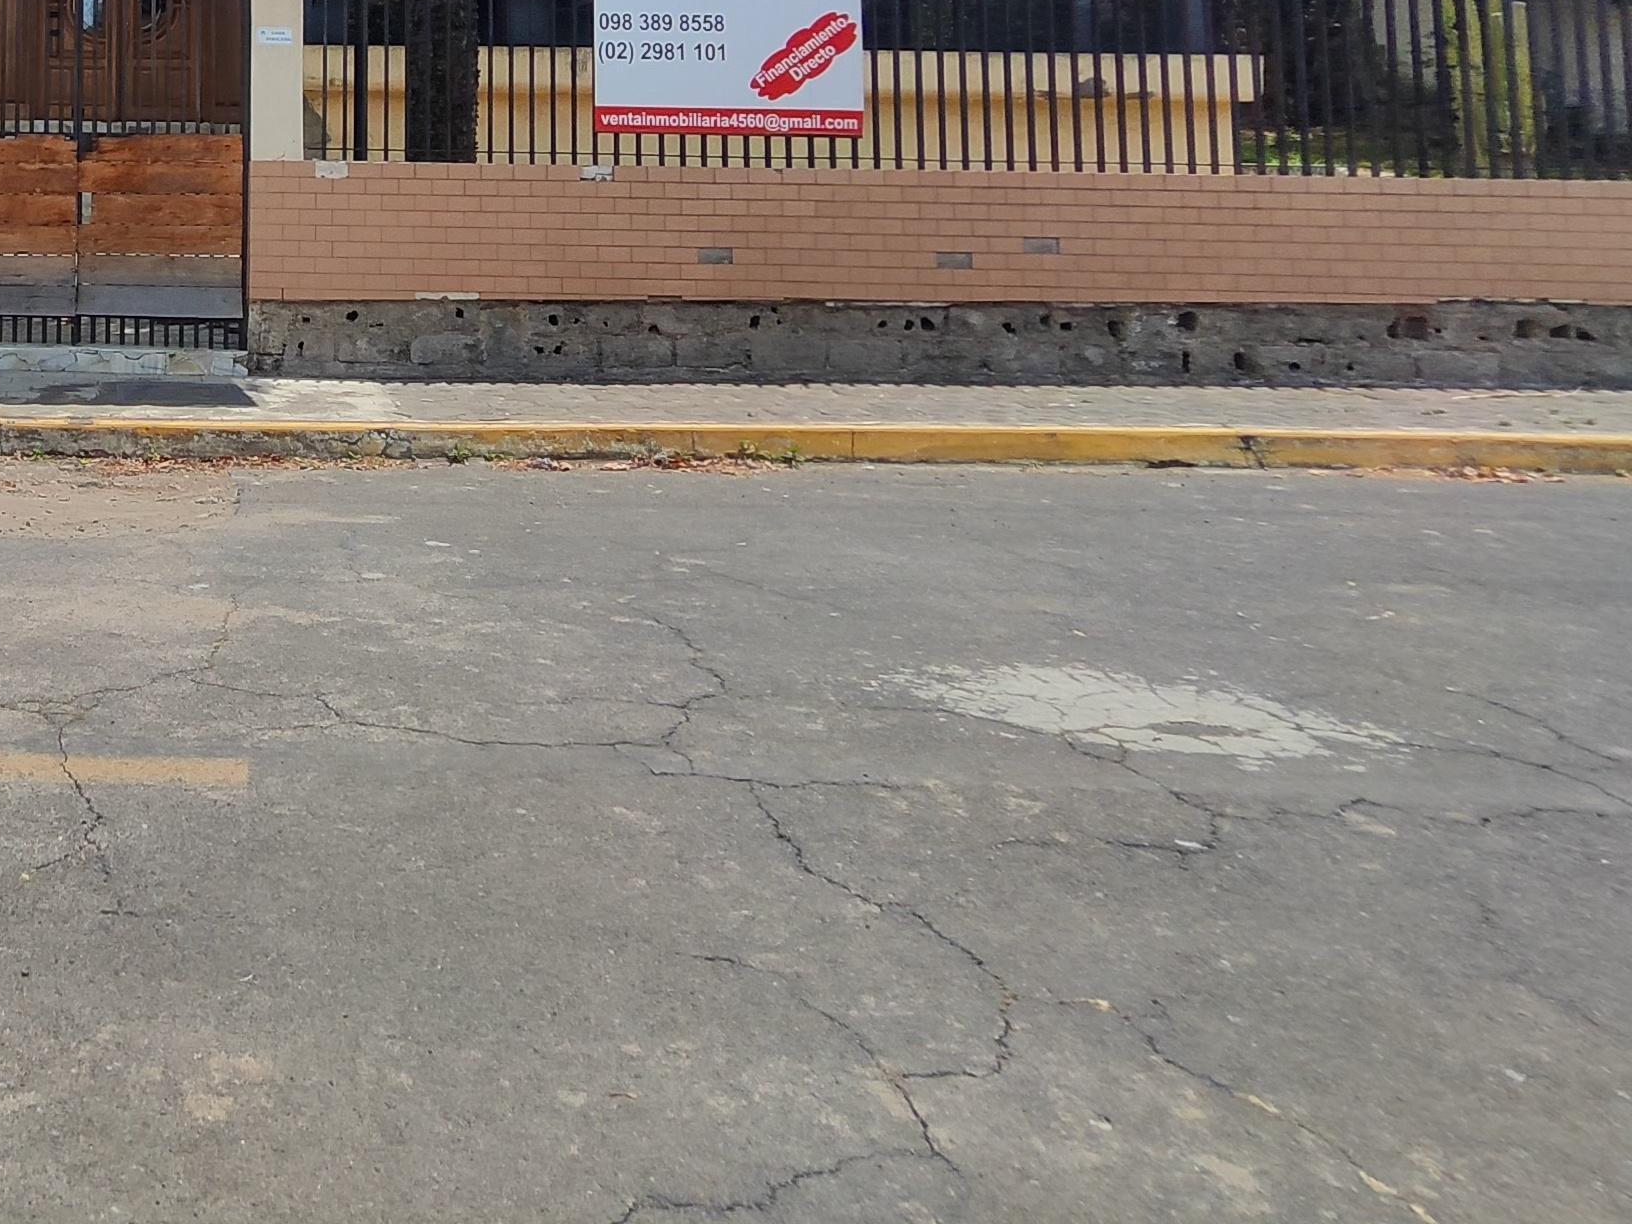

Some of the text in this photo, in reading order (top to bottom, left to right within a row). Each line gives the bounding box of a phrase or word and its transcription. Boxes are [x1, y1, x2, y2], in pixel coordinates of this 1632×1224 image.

[599, 13, 725, 32] 098 389 8558
[598, 41, 726, 64] (02) 2981 101
[755, 17, 848, 88] Financiamiento
[789, 45, 836, 82] Directo
[600, 111, 858, 132] ventainmobiliaria4560@gmail.com
